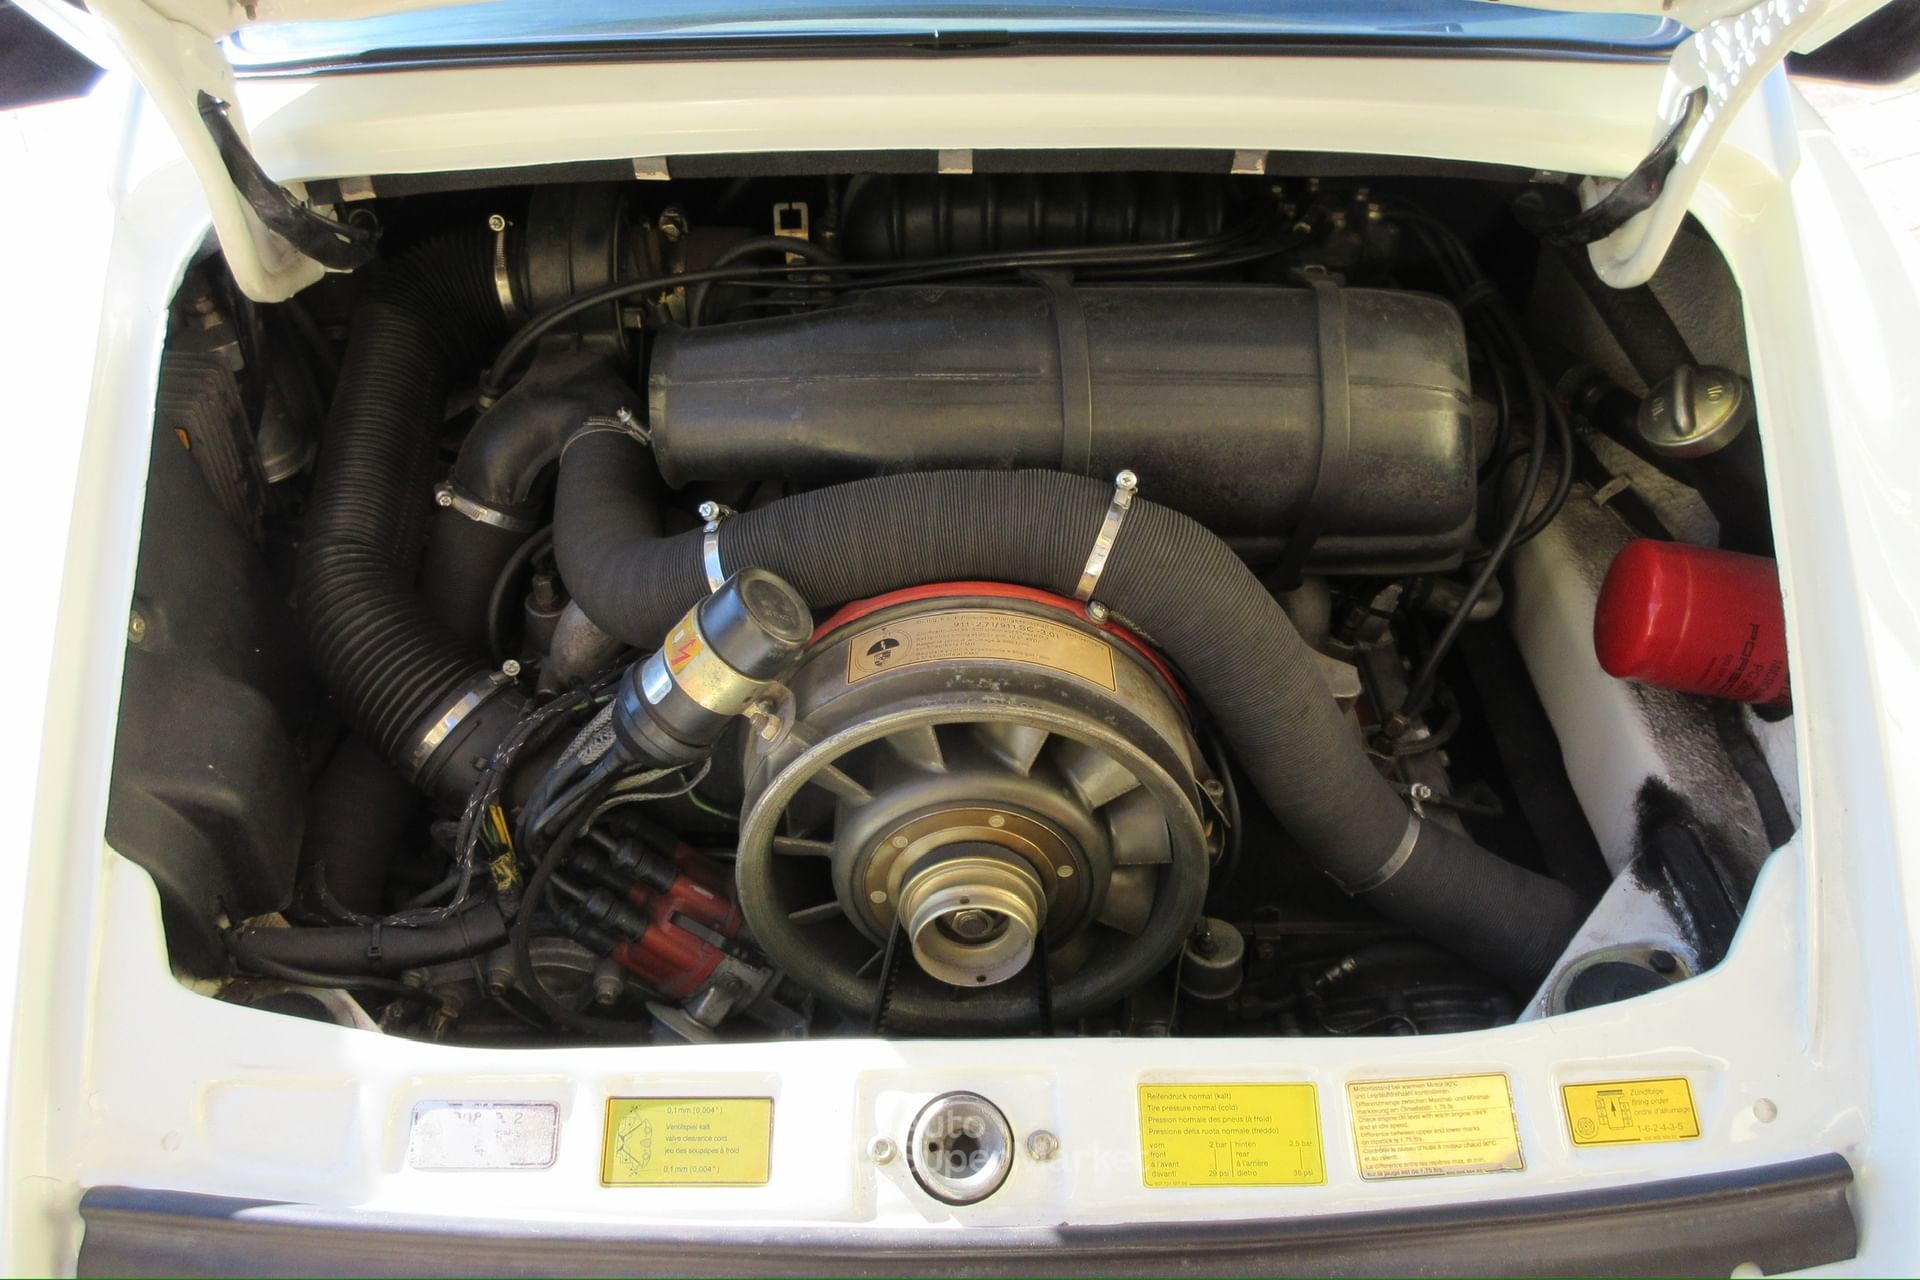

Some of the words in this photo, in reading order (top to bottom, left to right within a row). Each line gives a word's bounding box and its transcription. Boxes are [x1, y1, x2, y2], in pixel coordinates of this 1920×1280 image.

[1719, 623, 1760, 695] PORSC
[1630, 1088, 1664, 1096] Zündfolge
[1218, 1104, 1238, 1112] (cold)
[1252, 1127, 1279, 1135] (freddo)
[1638, 1123, 1684, 1133] 1-6-2-4-3-5
[1220, 1170, 1229, 1178] psi
